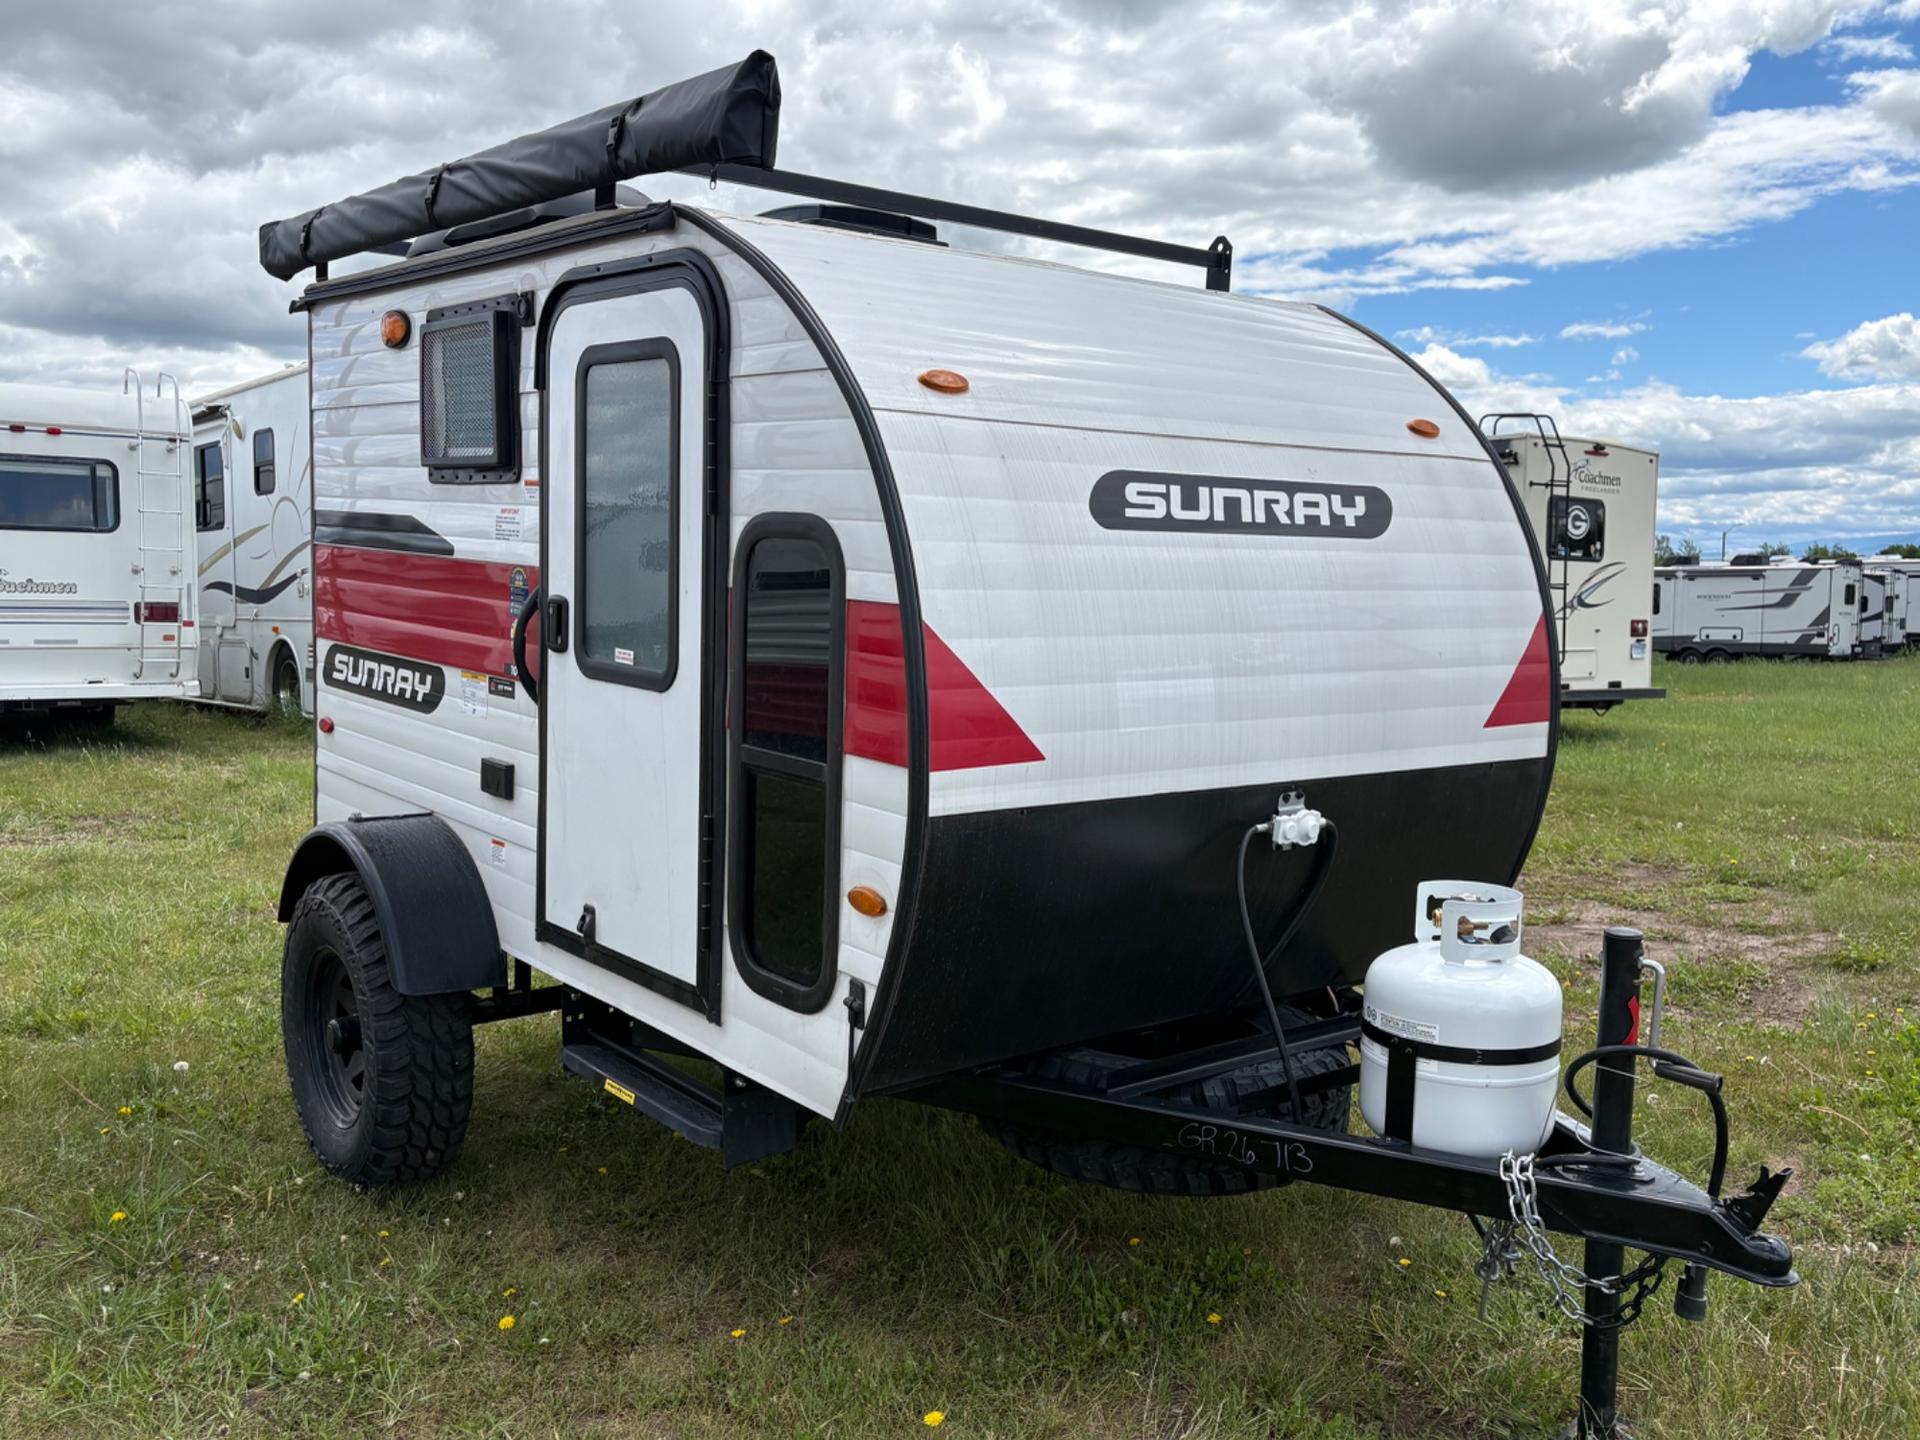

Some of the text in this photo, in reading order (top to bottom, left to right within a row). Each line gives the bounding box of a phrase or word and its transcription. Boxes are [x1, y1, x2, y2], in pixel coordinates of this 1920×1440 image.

[1578, 470, 1621, 486] Coachmen
[1124, 481, 1366, 527] SUNRAY
[332, 653, 432, 702] SUNRAY
[1260, 1140, 1313, 1173] 713
